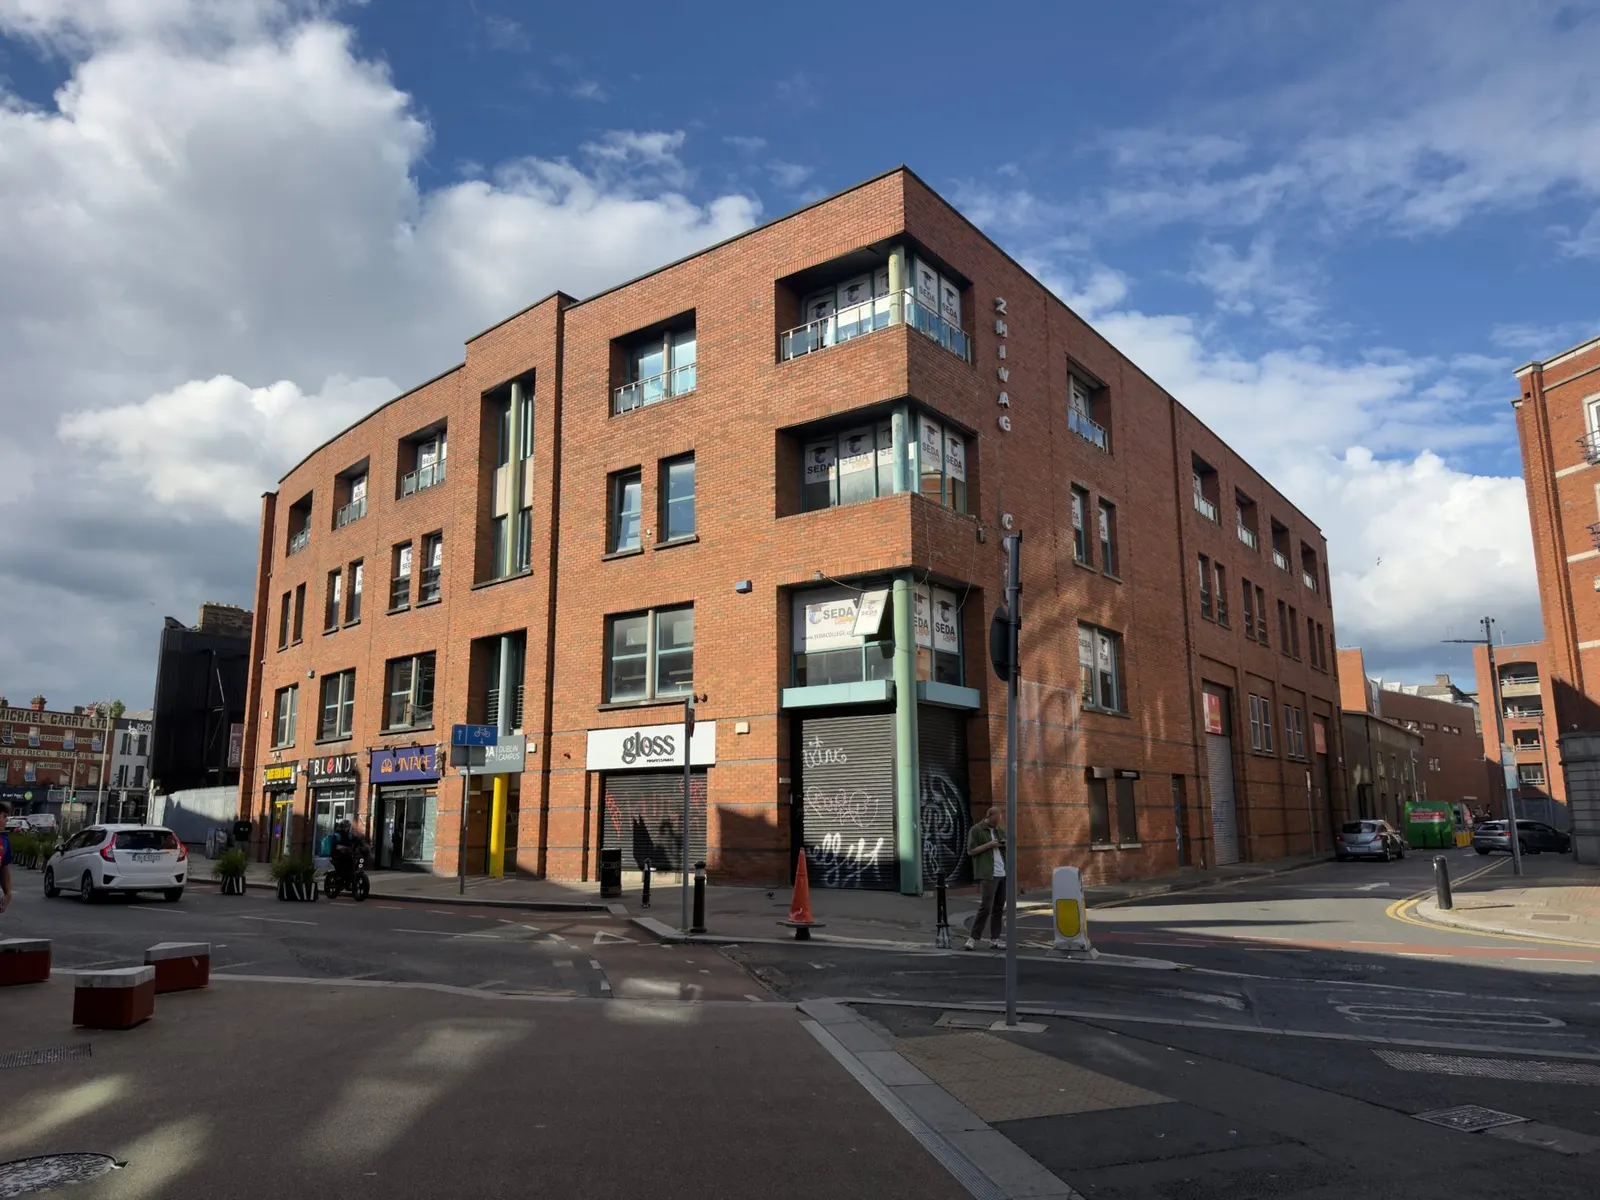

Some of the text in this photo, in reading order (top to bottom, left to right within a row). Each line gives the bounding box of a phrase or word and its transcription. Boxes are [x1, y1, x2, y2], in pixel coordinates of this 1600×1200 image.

[919, 285, 936, 304] SEDA
[942, 302, 958, 321] SEDA
[922, 442, 940, 458] SEDA
[842, 454, 869, 466] SEDA
[945, 454, 963, 470] SEDA
[807, 462, 834, 474] SEDA
[823, 606, 854, 620] SEDA
[914, 616, 929, 630] EDA
[935, 621, 956, 636] SEDA
[51, 713, 85, 727] GARRY
[498, 744, 519, 753] DUBLIN
[621, 731, 675, 764] gloss
[498, 752, 520, 761] CAMPUS
